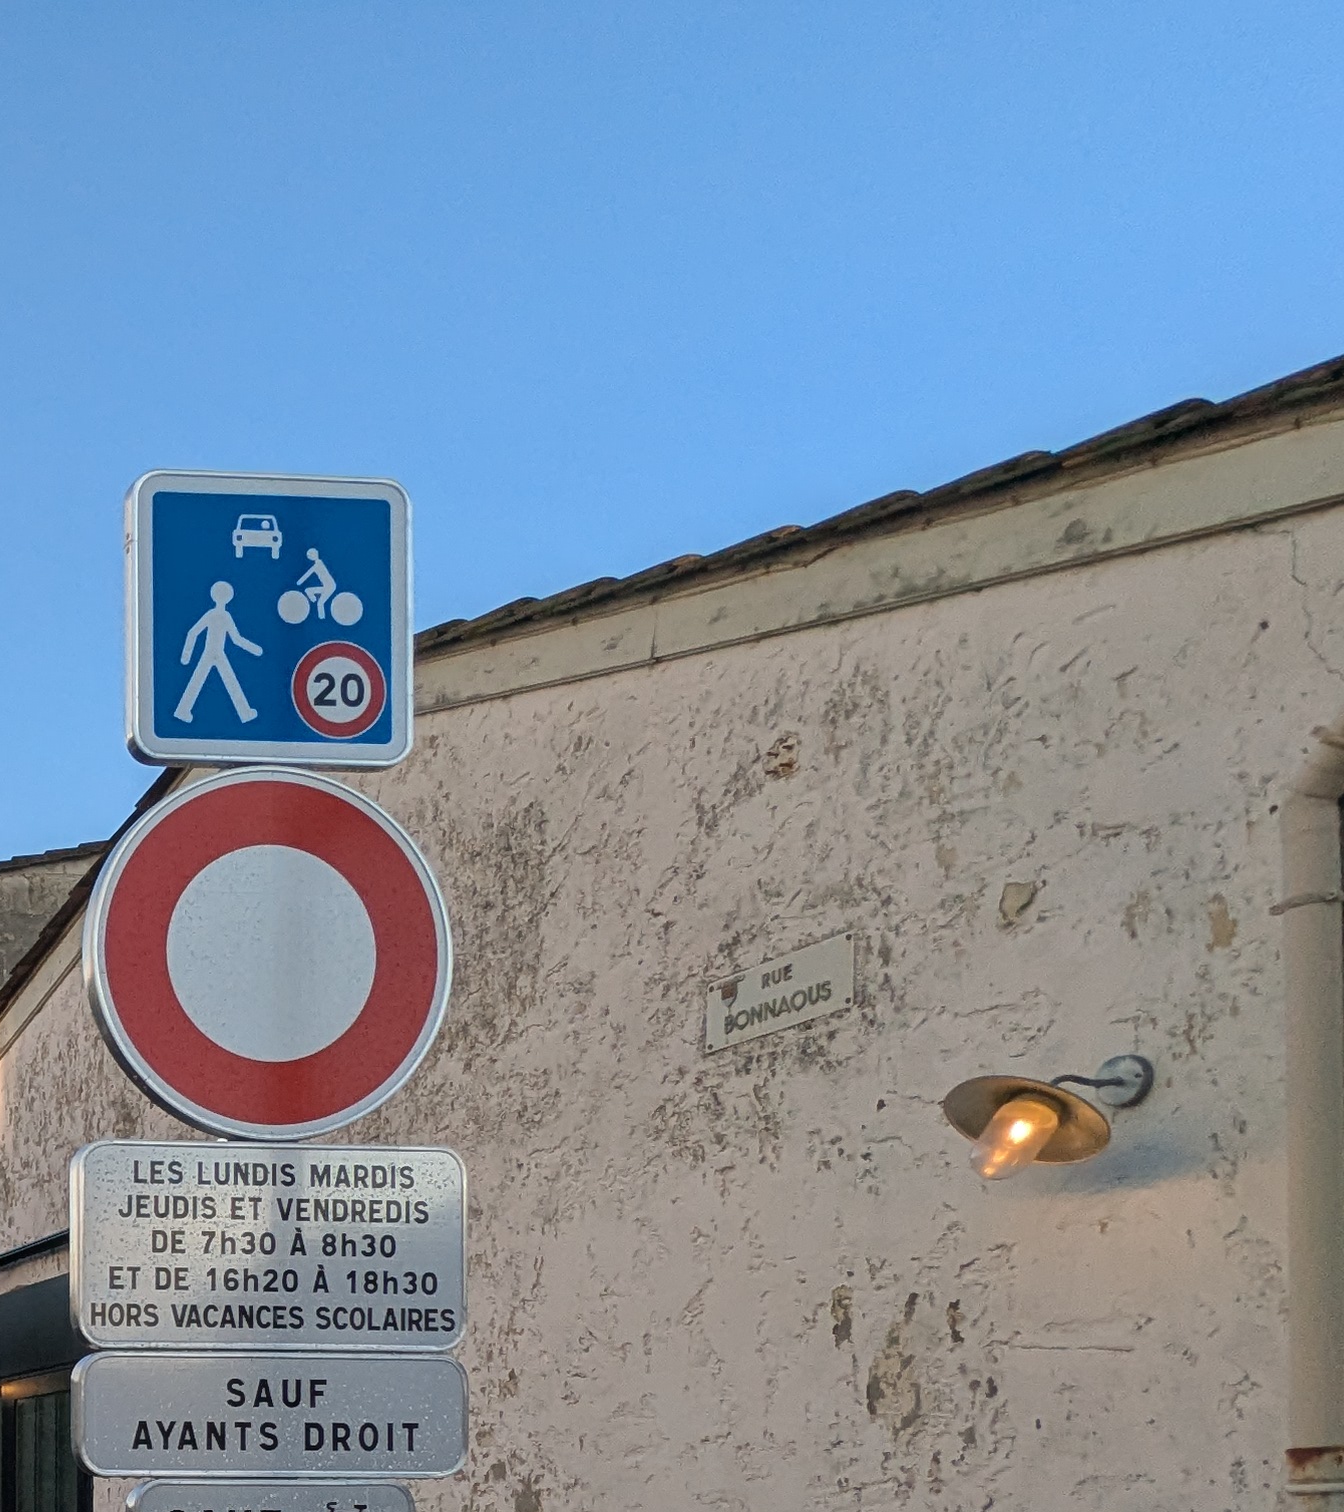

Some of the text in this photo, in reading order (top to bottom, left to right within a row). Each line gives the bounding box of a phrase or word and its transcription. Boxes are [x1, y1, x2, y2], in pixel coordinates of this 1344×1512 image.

[313, 672, 365, 707] 20
[761, 963, 793, 989] RUE
[723, 981, 832, 1035] BONNAOUS
[133, 1160, 415, 1189] LES LUNDIS MARDIS
[118, 1195, 430, 1225] JEUDIS ET VENDREDIS
[151, 1226, 397, 1258] DE 7h30 À 8h30
[108, 1264, 439, 1296] ET DE 16h20 À 18h30
[90, 1303, 456, 1333] HORS VACANCES SCOLAIRES
[226, 1378, 328, 1409] SAUF
[131, 1420, 420, 1453] AYANTS DROIT
